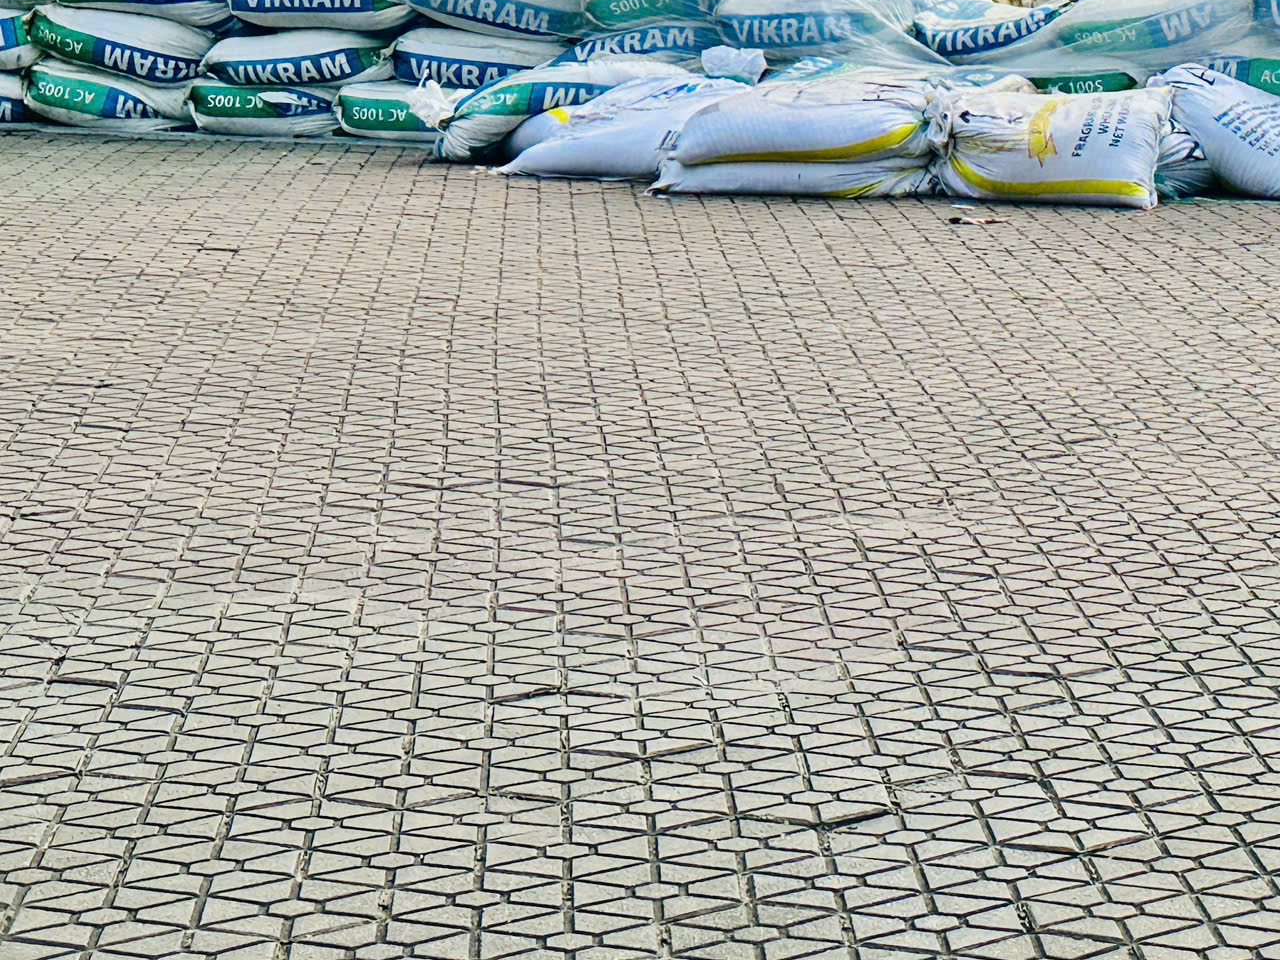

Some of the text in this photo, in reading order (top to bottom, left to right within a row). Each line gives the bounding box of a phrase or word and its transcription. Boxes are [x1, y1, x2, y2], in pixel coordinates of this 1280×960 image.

[731, 15, 852, 44] VIKRAM
[573, 28, 696, 62] VIKRAM
[64, 38, 84, 55] AC
[103, 44, 197, 79] IKRAM
[226, 52, 353, 85] VIKRAM
[410, 57, 521, 87] VIKRA
[1260, 69, 1280, 84] AC
[38, 81, 95, 105] AC 100S
[1068, 79, 1104, 94] 100S
[207, 94, 242, 108] 100S
[352, 106, 407, 121] AC 100S
